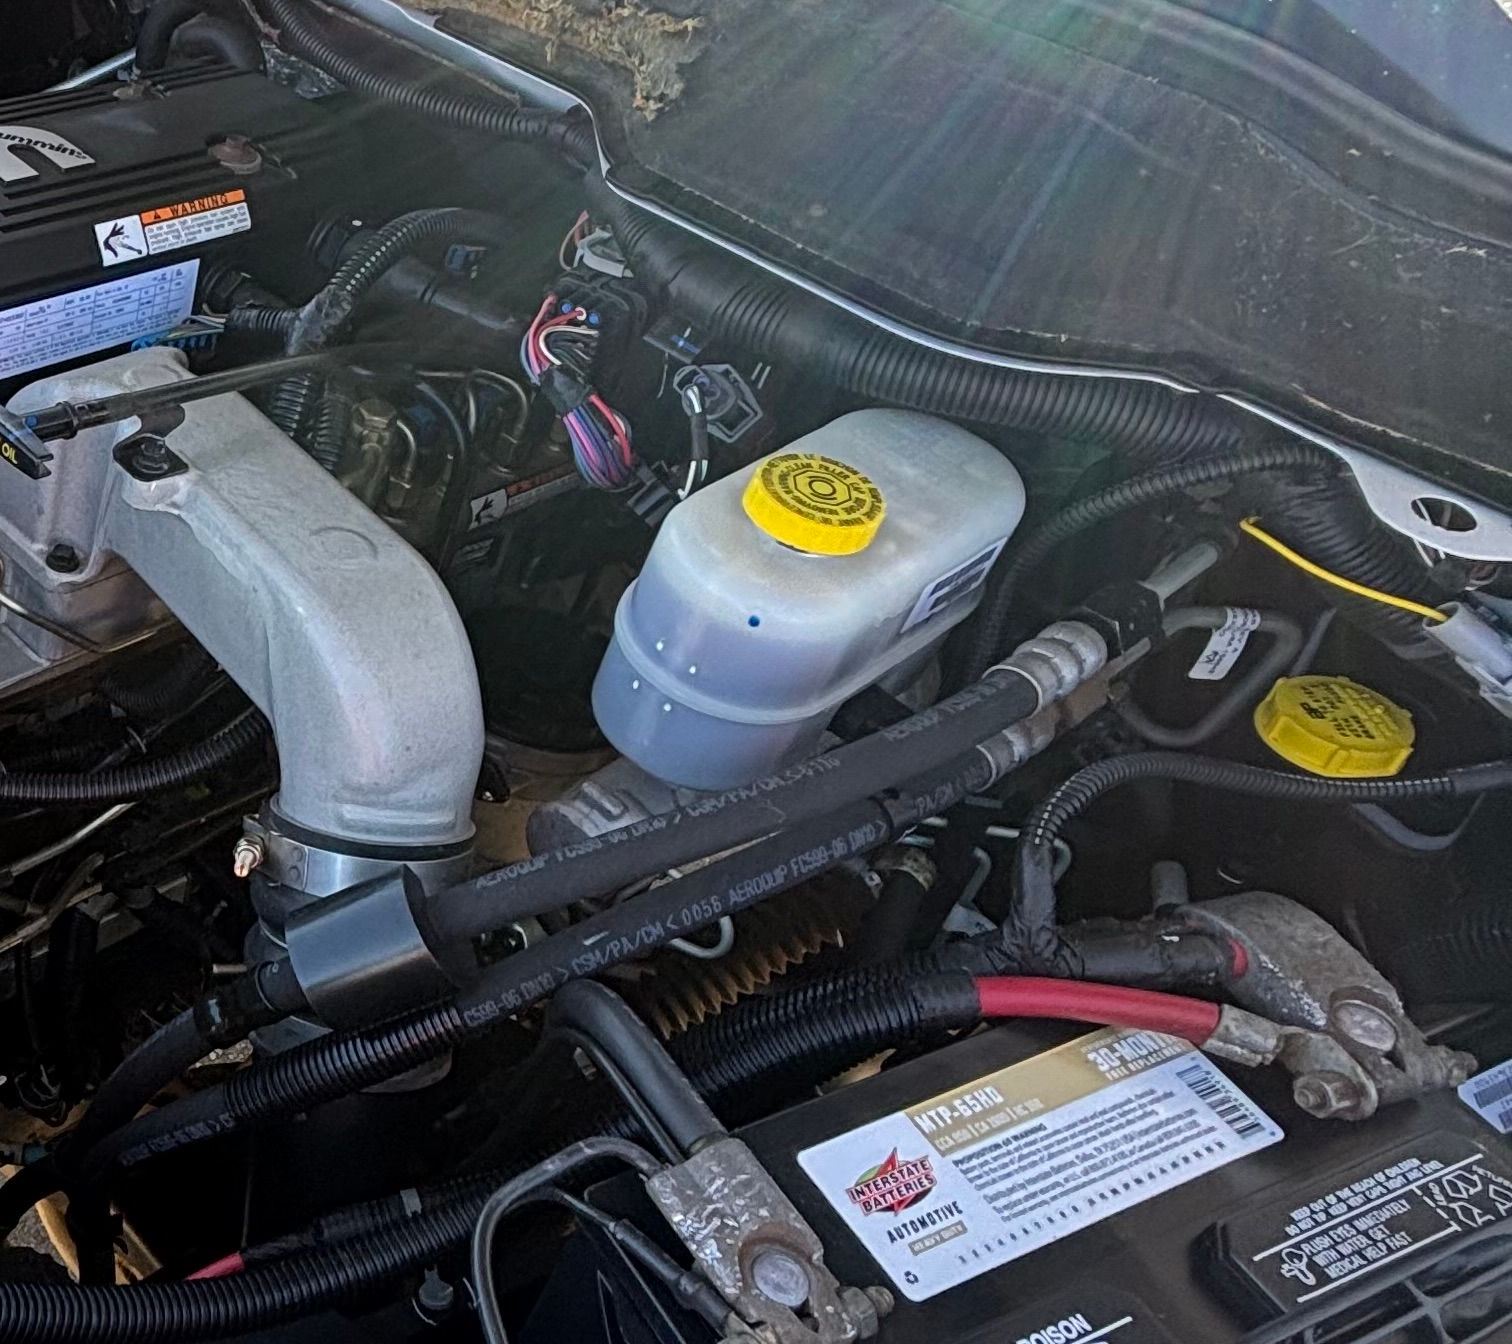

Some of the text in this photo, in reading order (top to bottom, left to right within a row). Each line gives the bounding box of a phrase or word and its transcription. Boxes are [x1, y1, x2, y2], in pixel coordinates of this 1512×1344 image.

[170, 194, 228, 217] WARNING
[2, 443, 18, 465] OIL
[819, 464, 850, 480] FILLER
[914, 1086, 1004, 1134] MTP-65HD
[848, 1159, 932, 1200] INTERSTATE
[859, 1173, 937, 1212] BATTERIES
[882, 1200, 964, 1243] AUTOMOTIVE
[1299, 1196, 1412, 1256] FLUSH EYES IMMEDIATELY
[1311, 1246, 1340, 1268] WITH
[1368, 1222, 1391, 1242] GET
[1323, 1229, 1413, 1280] MEDICAL HELP FAST
